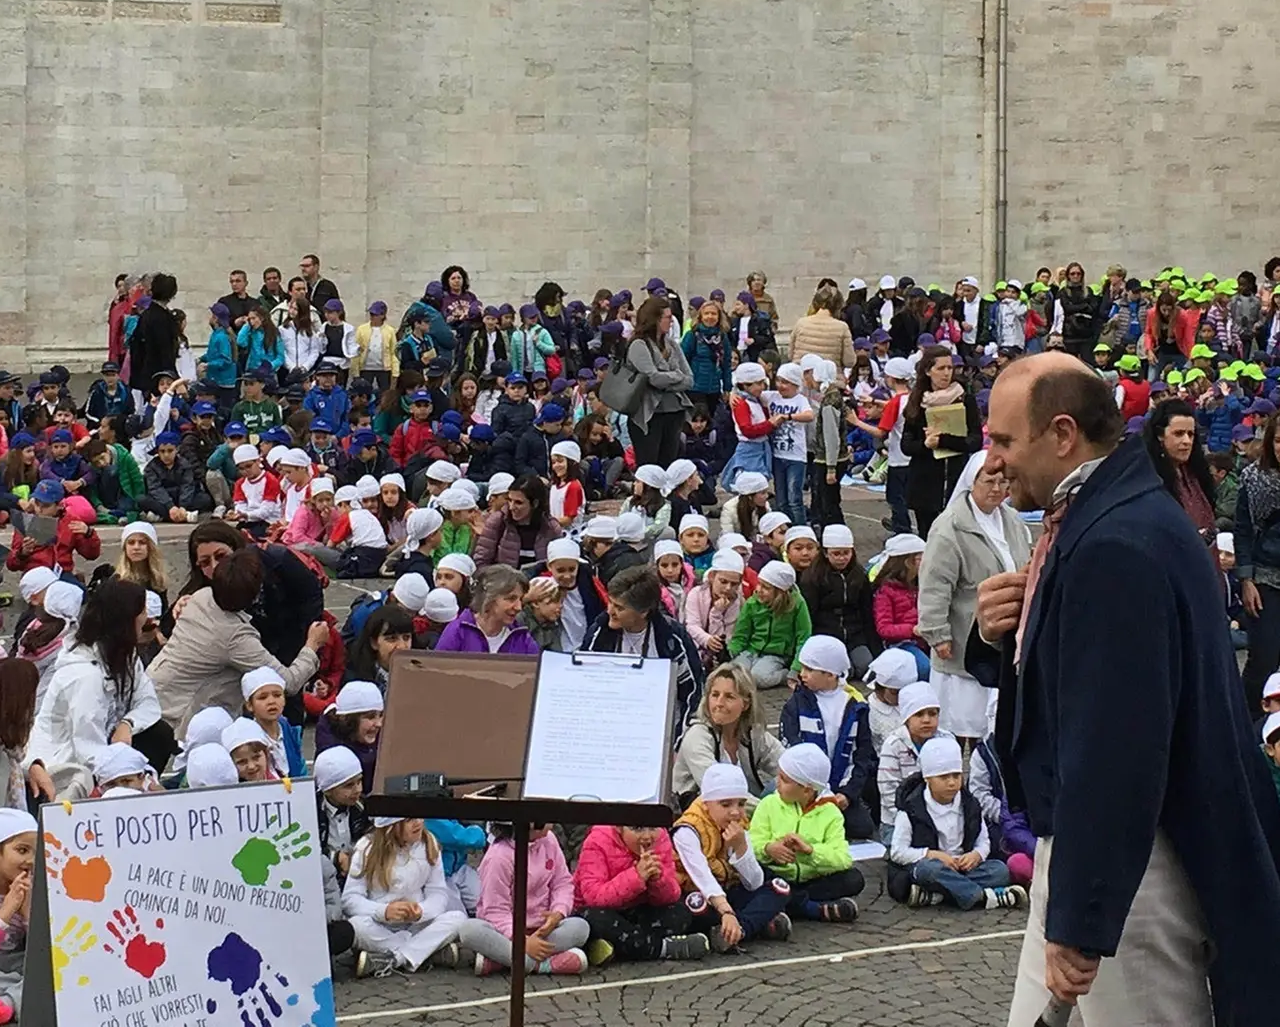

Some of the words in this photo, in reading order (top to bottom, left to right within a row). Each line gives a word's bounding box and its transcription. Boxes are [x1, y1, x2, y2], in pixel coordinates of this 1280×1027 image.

[115, 812, 177, 848] POSTO
[188, 806, 223, 841] PER
[234, 800, 292, 833] TUTTI
[128, 863, 142, 883] LA
[146, 867, 175, 889] PACE
[179, 869, 187, 892] È
[192, 875, 209, 895] UN
[213, 879, 246, 902] DONO
[123, 889, 179, 916] COMINCIA
[184, 899, 199, 920] DA
[93, 994, 113, 1013] FAI
[116, 985, 144, 1008] AGLI
[148, 974, 178, 998] ALTRI
[150, 993, 205, 1024] VORRESTI
